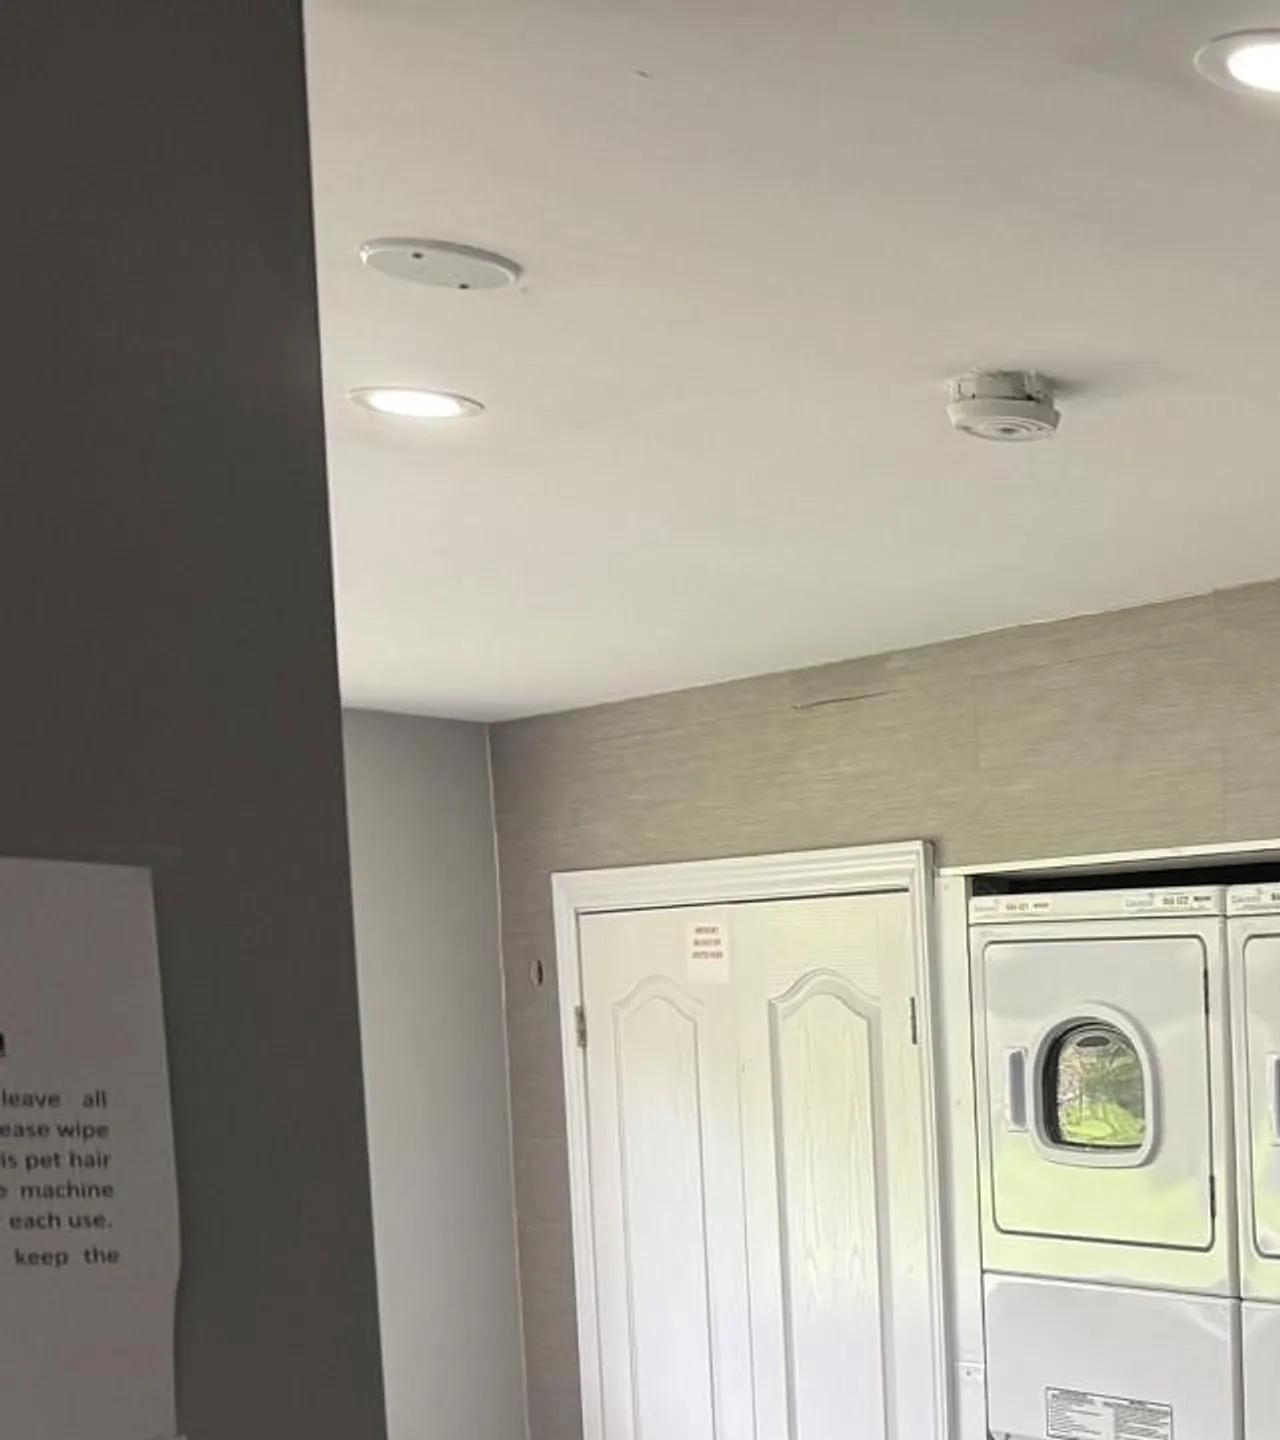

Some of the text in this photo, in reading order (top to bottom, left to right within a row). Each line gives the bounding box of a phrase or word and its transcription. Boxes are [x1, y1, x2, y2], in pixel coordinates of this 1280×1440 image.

[2, 1088, 108, 1109] leave all
[57, 1120, 110, 1145] wipe
[25, 1152, 60, 1173] pet
[68, 1150, 112, 1169] hair
[21, 1180, 114, 1199] machine
[9, 1212, 113, 1230] each use.
[14, 1245, 120, 1270] keep the
